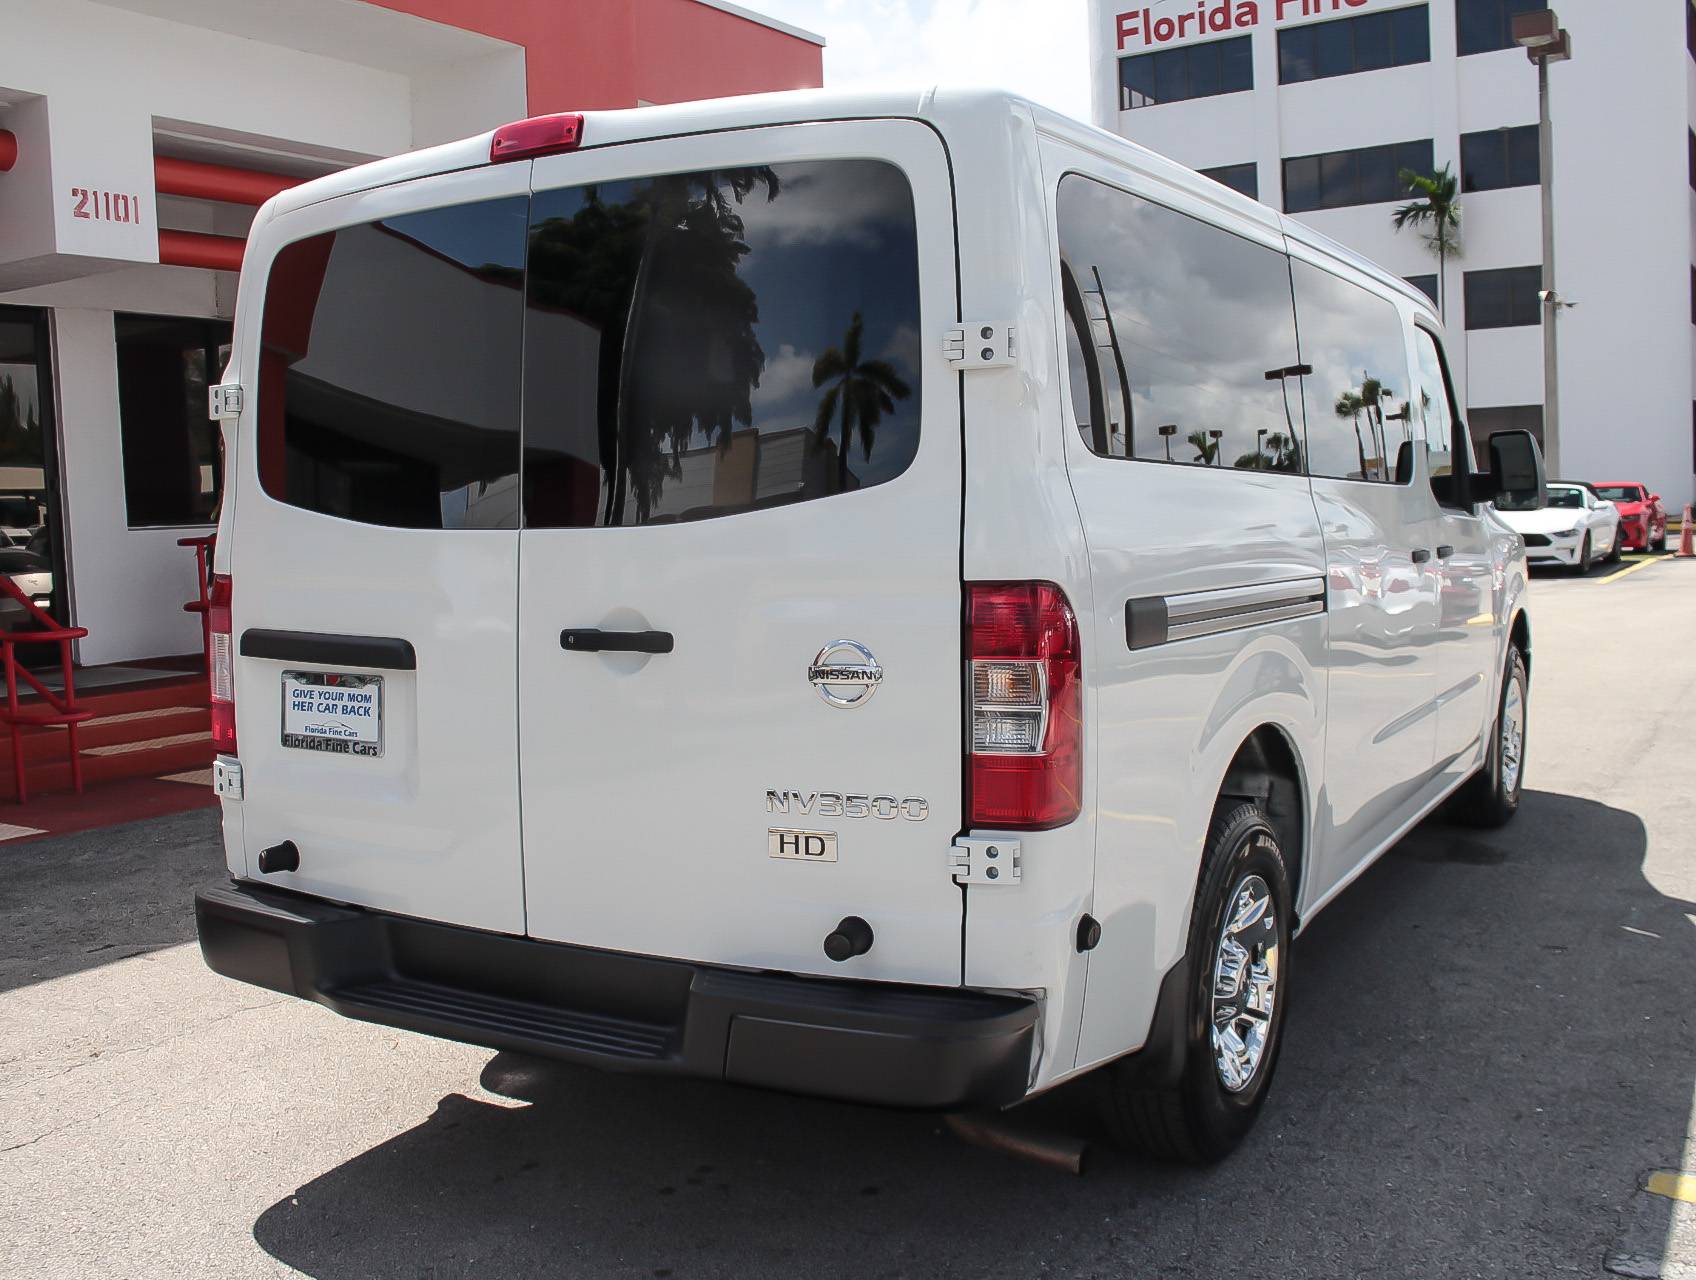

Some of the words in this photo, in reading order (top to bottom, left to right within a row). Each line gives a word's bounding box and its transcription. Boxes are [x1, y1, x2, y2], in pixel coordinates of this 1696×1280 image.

[1115, 0, 1258, 50] Florida
[71, 187, 140, 225] 21101
[813, 668, 877, 681] NISSAN
[292, 688, 315, 700] GIVE
[317, 690, 345, 702] YOUR
[347, 692, 372, 704] MOM
[292, 700, 313, 712] HER
[316, 702, 338, 714] CAR
[341, 704, 371, 717] BACK
[304, 725, 327, 735] Florida
[328, 727, 342, 736] Fine
[343, 729, 358, 738] Cars
[284, 735, 322, 749] Florida
[325, 738, 349, 753] Fine
[352, 741, 378, 757] Cars
[766, 789, 929, 821] NV3500
[779, 833, 826, 857] HD
